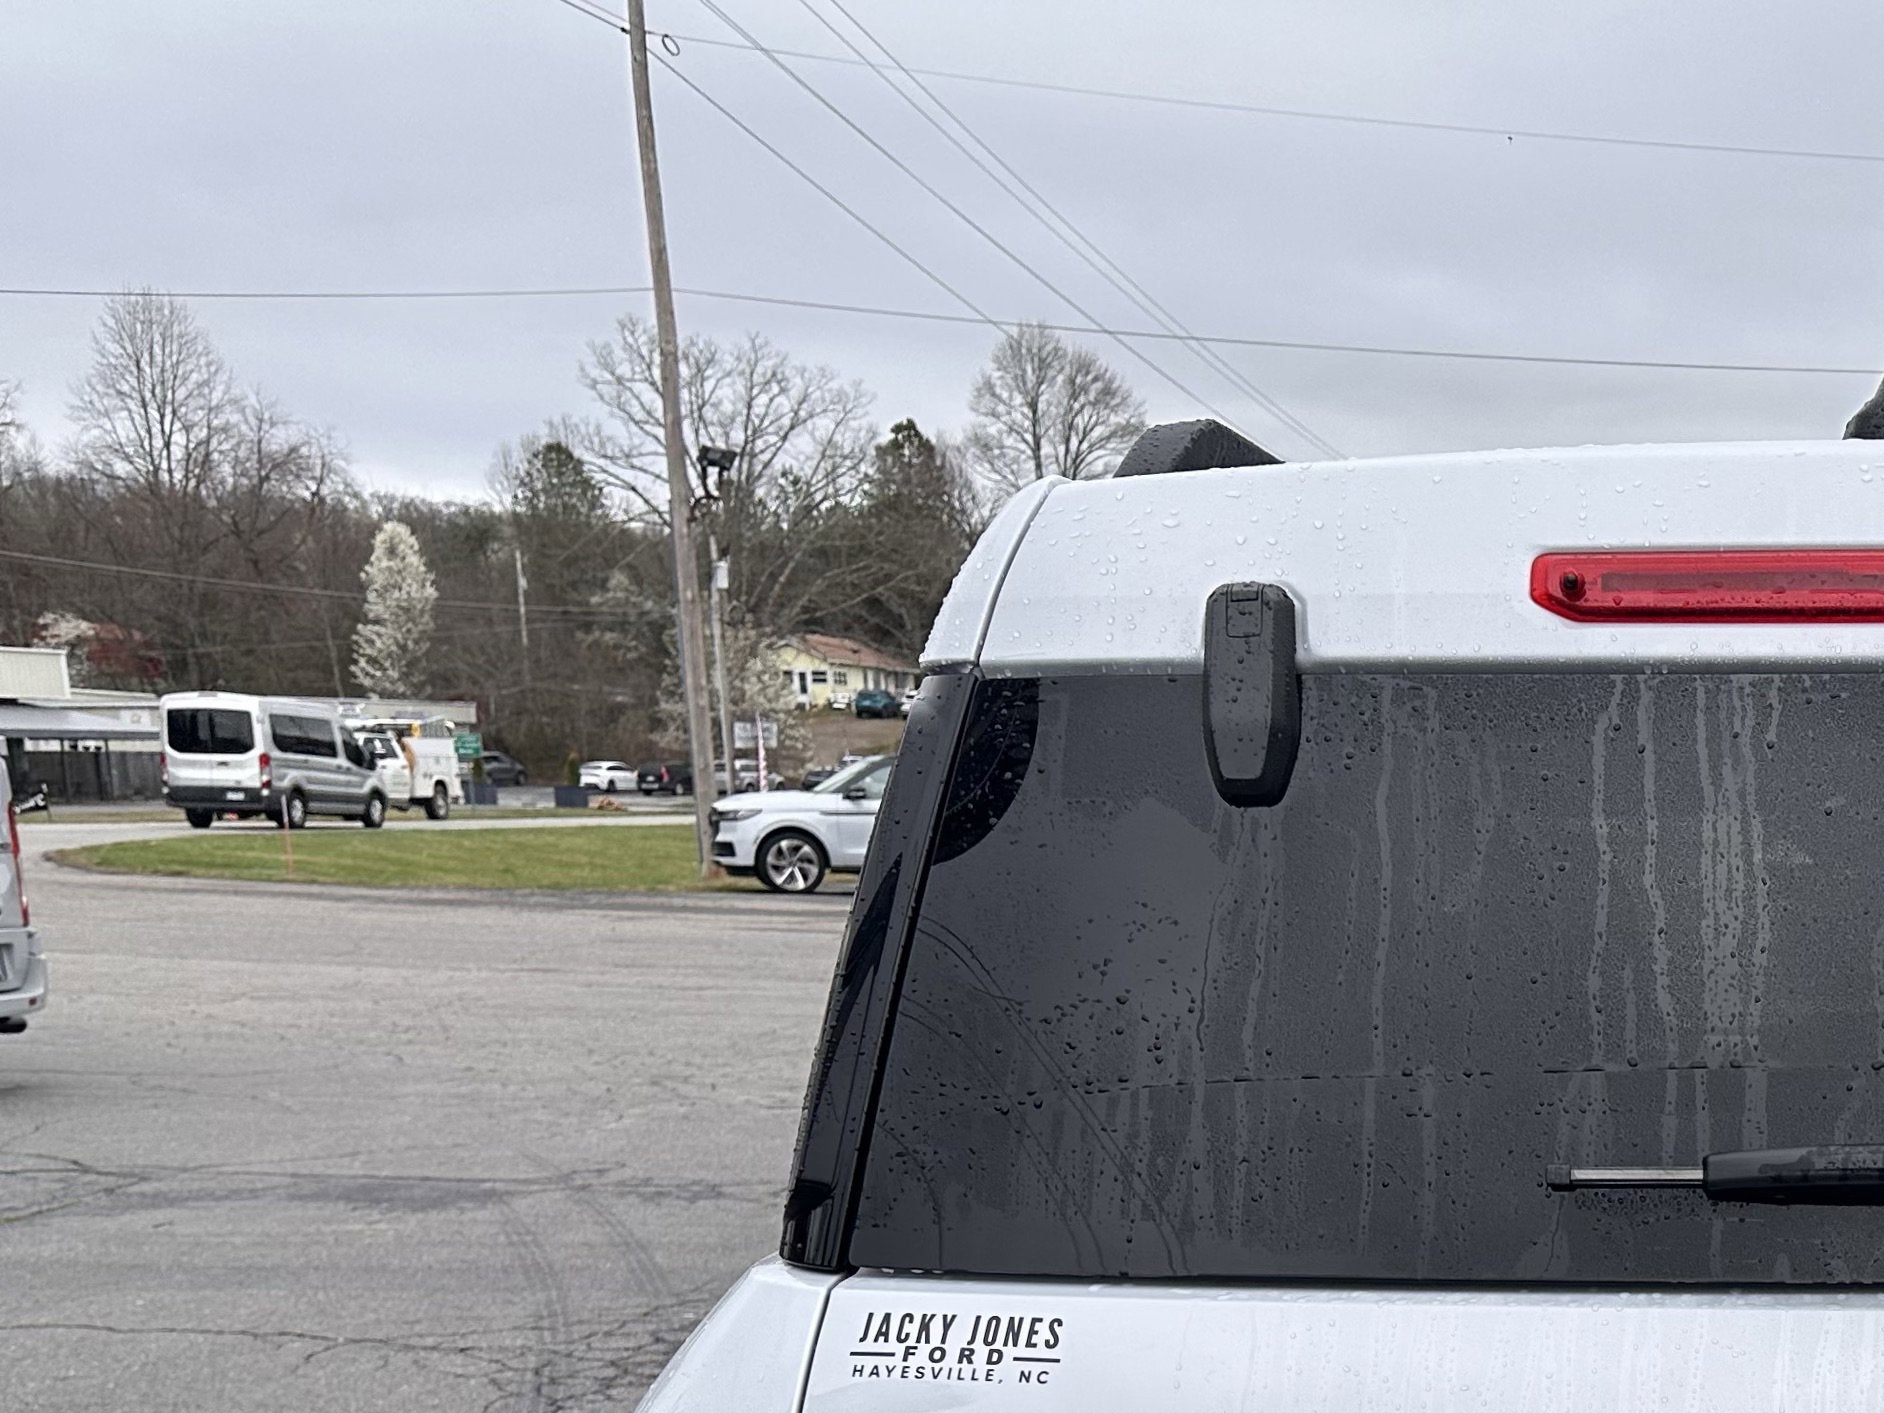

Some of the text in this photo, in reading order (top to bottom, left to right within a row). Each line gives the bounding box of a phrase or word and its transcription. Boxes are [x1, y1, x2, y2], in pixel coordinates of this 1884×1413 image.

[859, 1312, 1063, 1349] JACKY JONES
[902, 1346, 1004, 1366] FORD
[852, 1365, 1050, 1385] HAYESVILLE, NC
